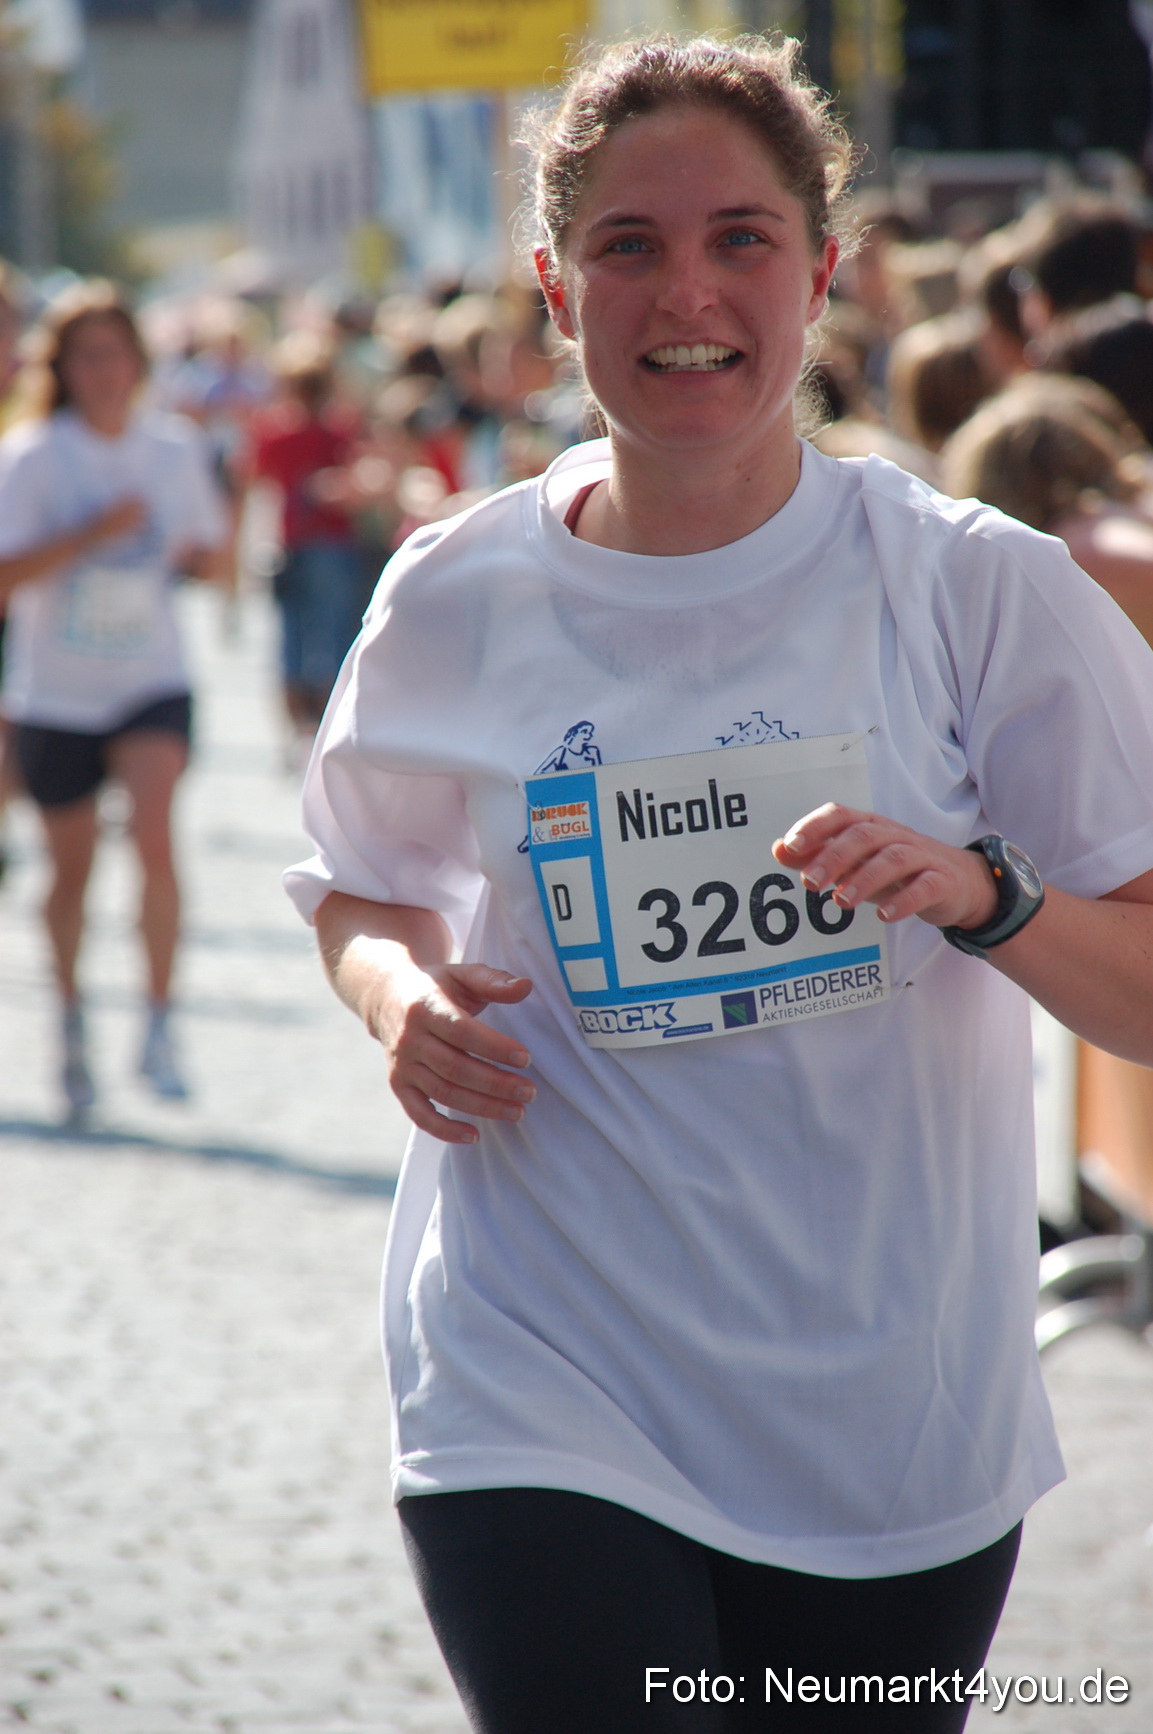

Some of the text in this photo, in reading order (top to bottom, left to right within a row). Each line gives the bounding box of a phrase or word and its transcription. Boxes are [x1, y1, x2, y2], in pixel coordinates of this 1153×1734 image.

[551, 820, 590, 837] BÜGL
[616, 778, 749, 842] Nicole
[551, 883, 573, 922] D
[637, 872, 856, 964] 3266
[759, 963, 883, 1009] PFLEIDERER
[762, 986, 884, 1023] AKTIENGESELLSCHAFT
[579, 1001, 678, 1034] BOCK
